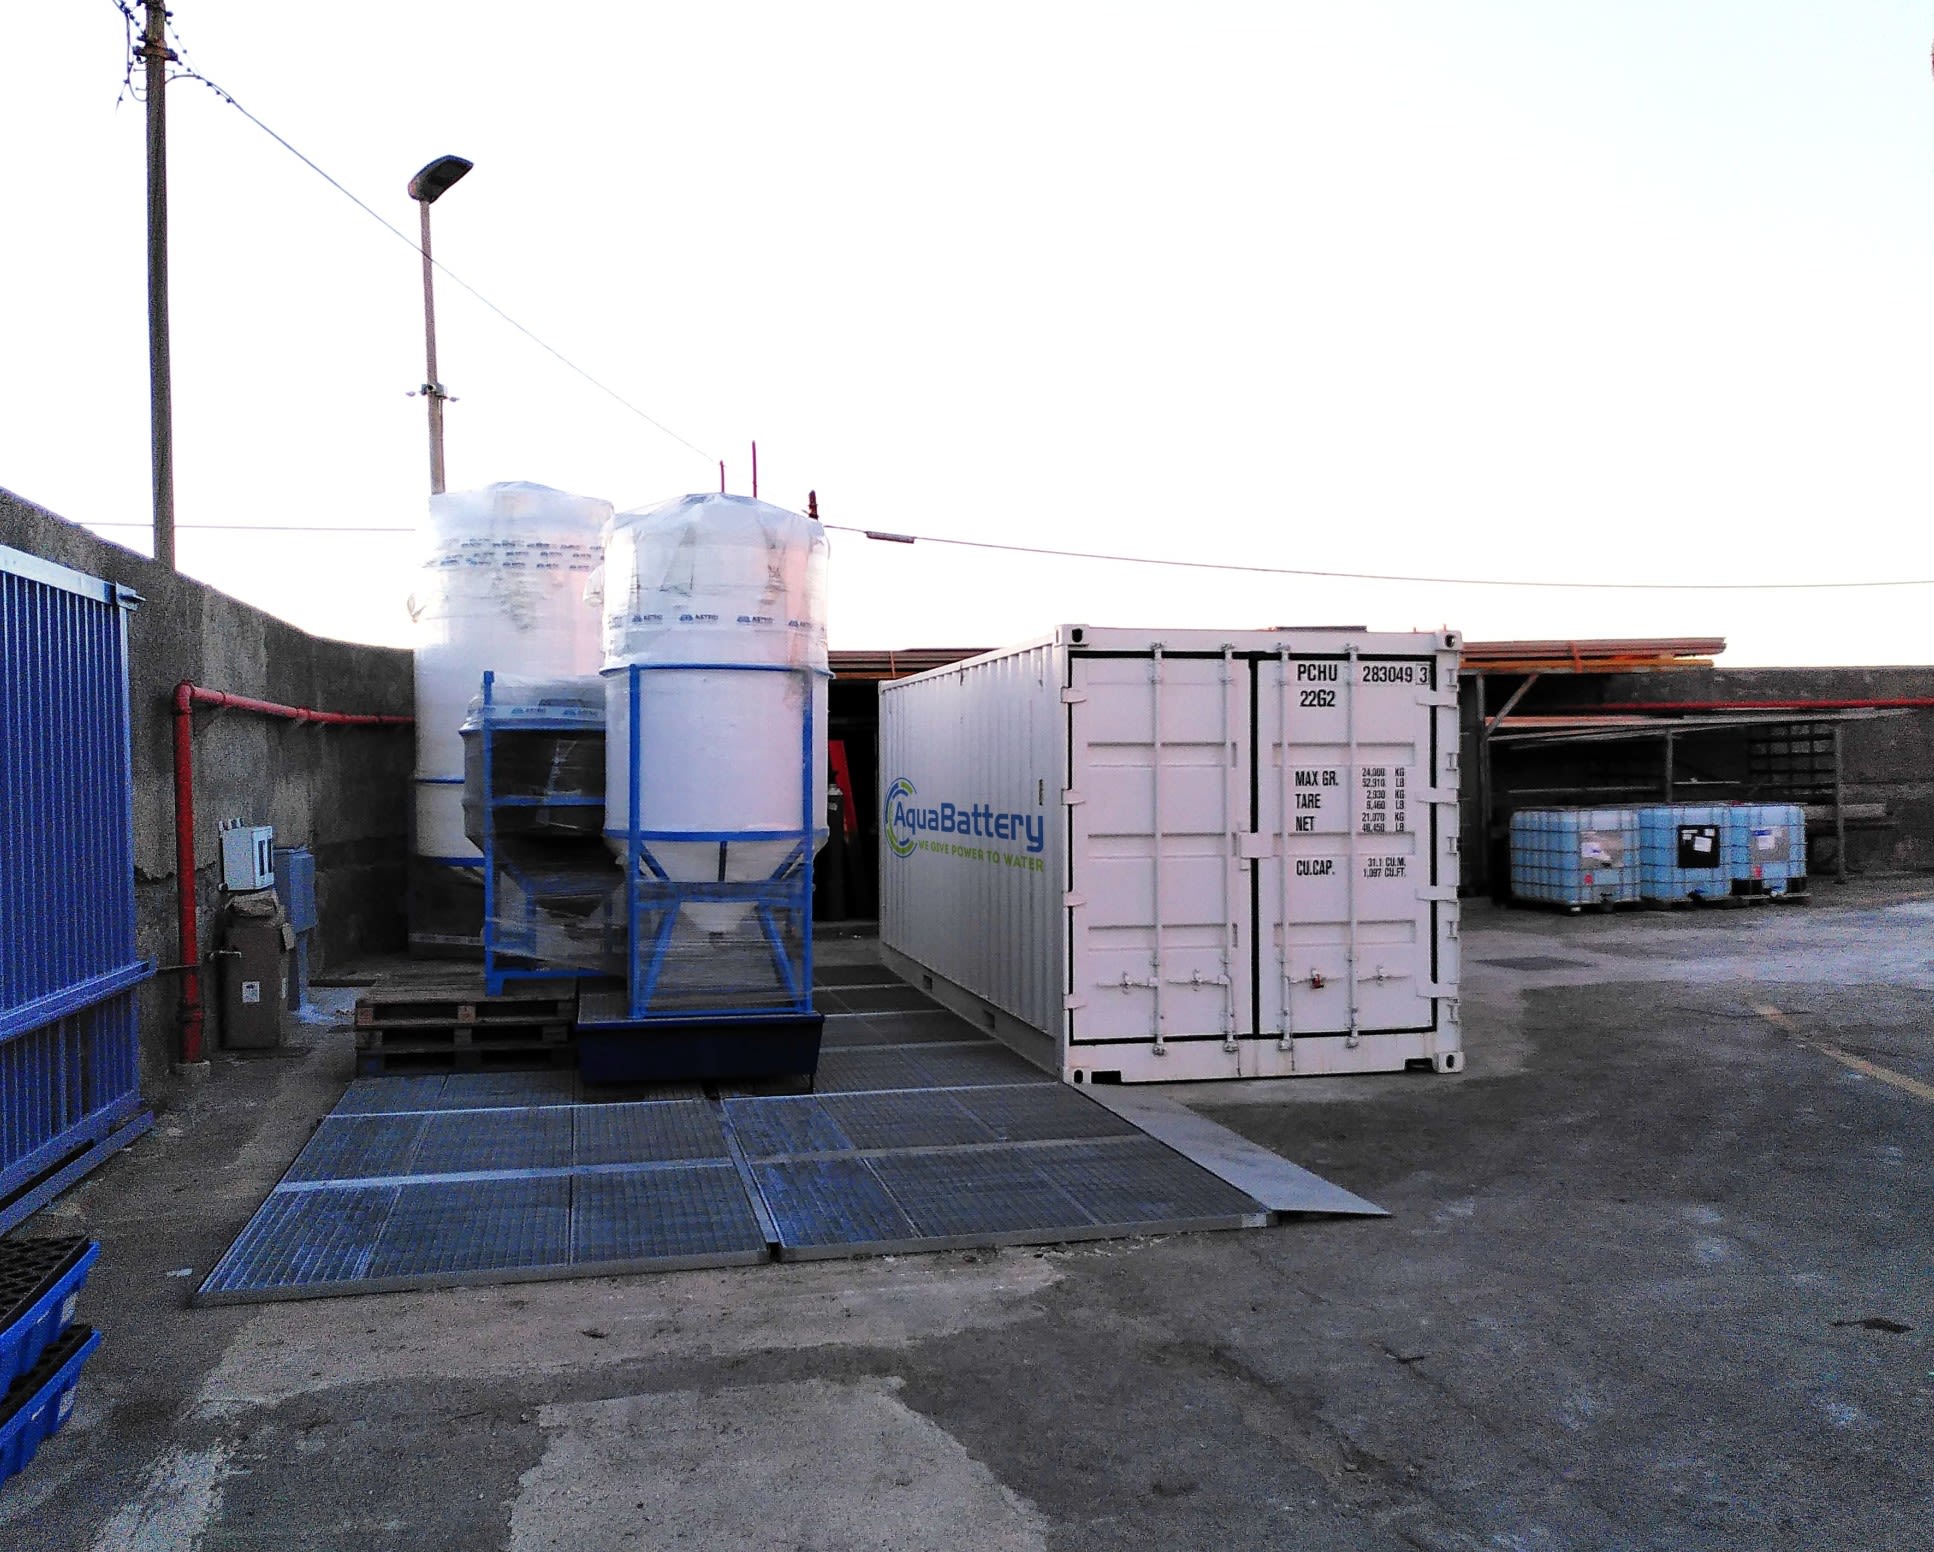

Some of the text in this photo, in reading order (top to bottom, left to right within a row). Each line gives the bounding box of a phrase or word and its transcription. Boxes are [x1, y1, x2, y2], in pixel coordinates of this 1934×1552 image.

[1297, 664, 1428, 683] PCHU 283049 3
[1300, 689, 1336, 707] 22G2
[1295, 771, 1339, 786] MAX GR.
[1394, 767, 1404, 777] KG
[1395, 778, 1404, 787] LB
[1295, 793, 1321, 809] TARE
[1394, 789, 1404, 799] KG
[1395, 800, 1404, 810] LB
[1296, 816, 1315, 831] NET
[1394, 812, 1404, 821] KG
[894, 801, 1044, 853] AquaBattery
[1395, 822, 1404, 832] LB
[918, 840, 1044, 872] WE GIVE POWER TO WATER
[1296, 859, 1335, 876] CU.CAP.
